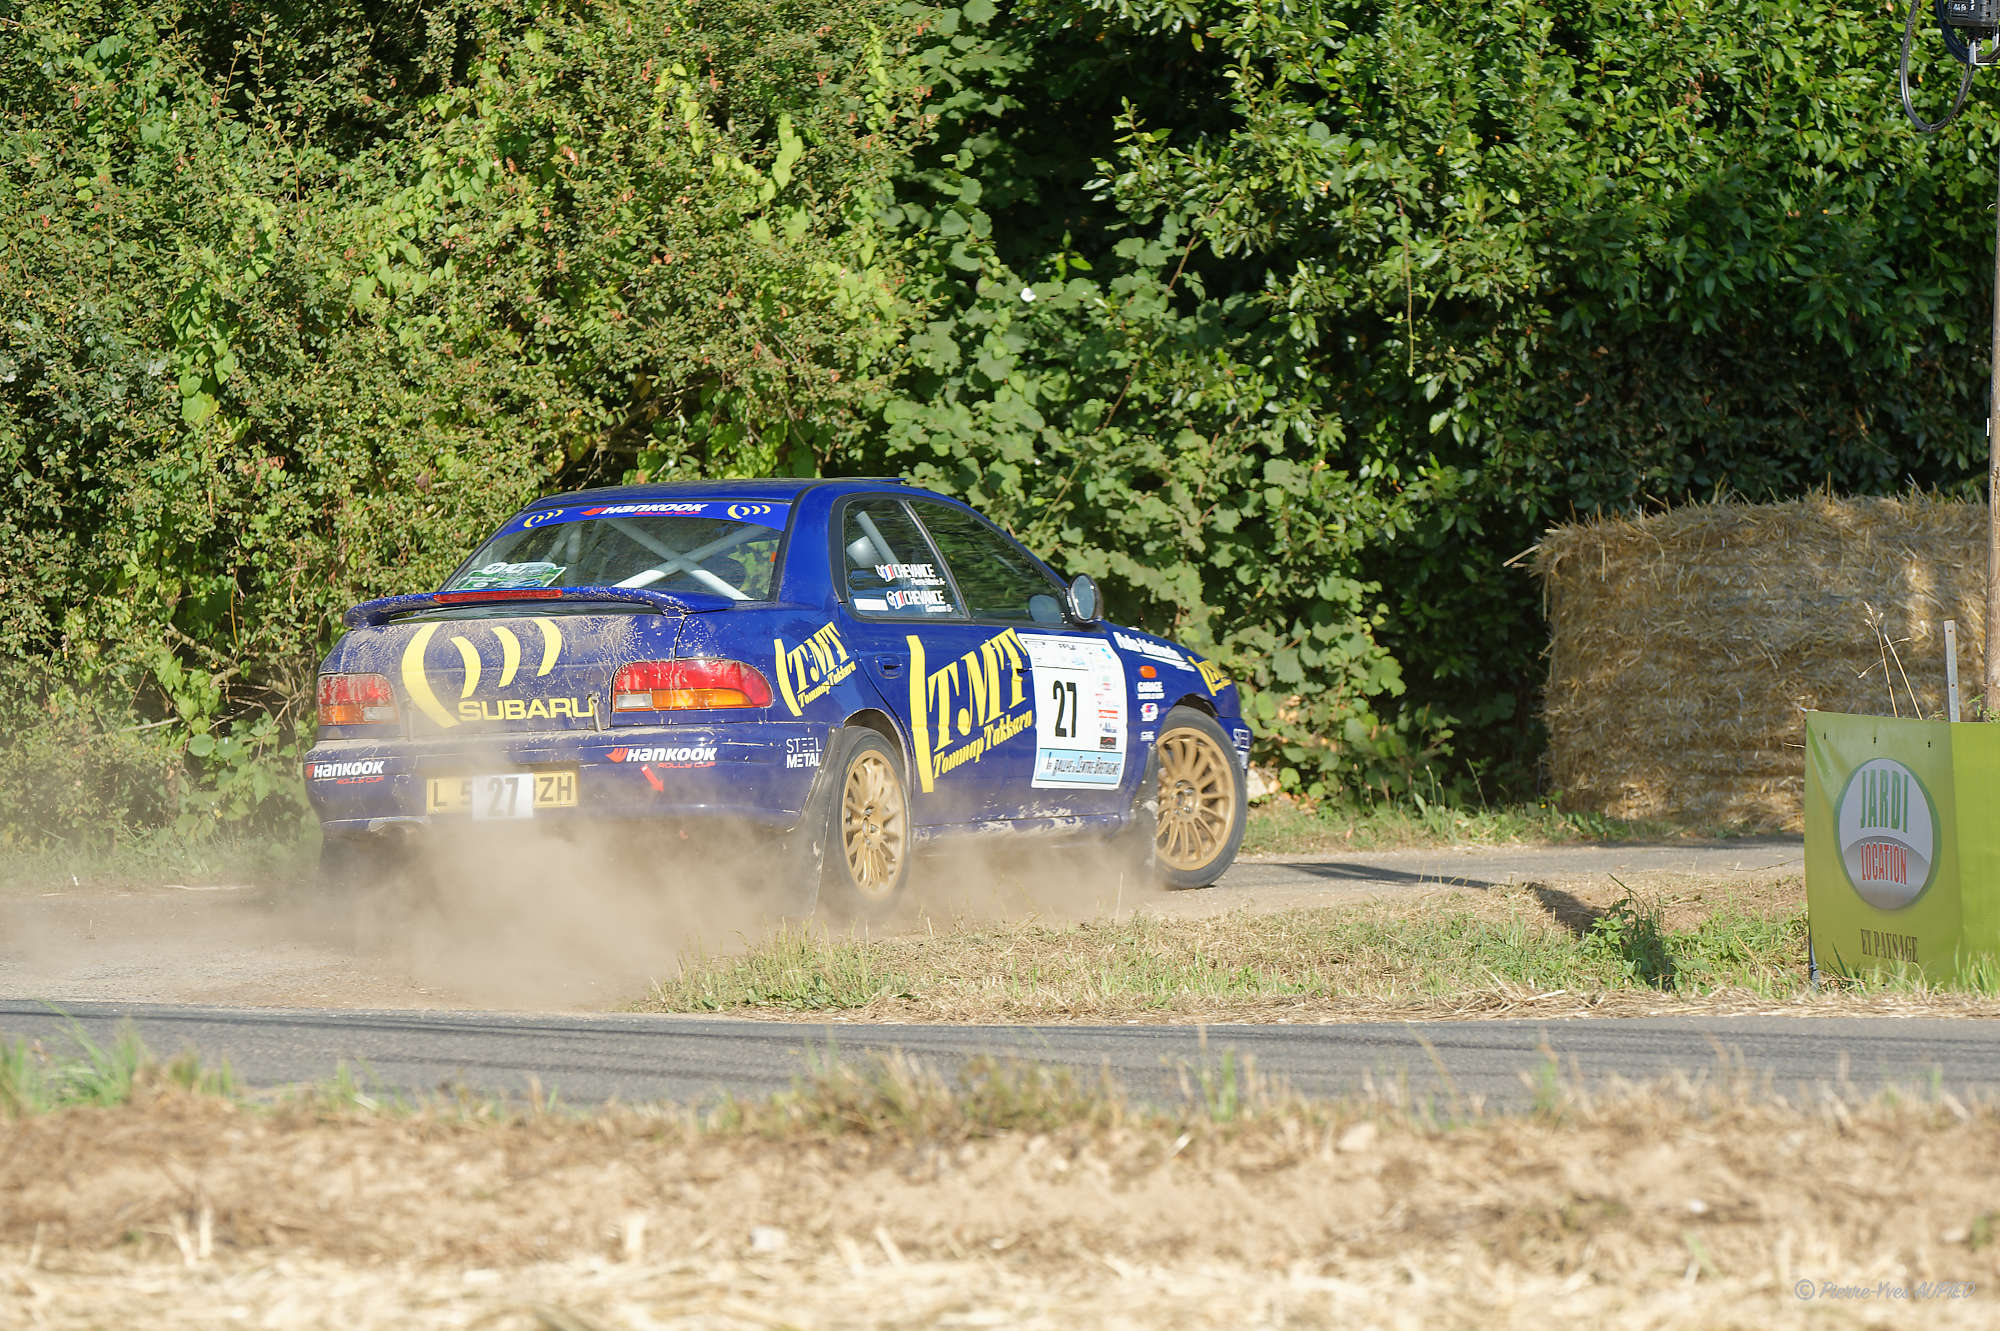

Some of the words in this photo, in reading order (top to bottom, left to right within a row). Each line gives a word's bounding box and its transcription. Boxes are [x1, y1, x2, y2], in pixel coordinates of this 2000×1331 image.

[786, 621, 850, 694] TMT
[457, 697, 594, 721] SUBARU
[927, 627, 1028, 752] TMT
[1053, 680, 1077, 738] 27
[786, 737, 823, 753] STEEL
[786, 753, 821, 769] METAL
[487, 776, 520, 817] 27
[534, 775, 573, 803] ZH
[1860, 768, 1909, 834] JARDI
[1860, 841, 1908, 886] LOCATION
[1873, 930, 1919, 963] PAYSAGE
